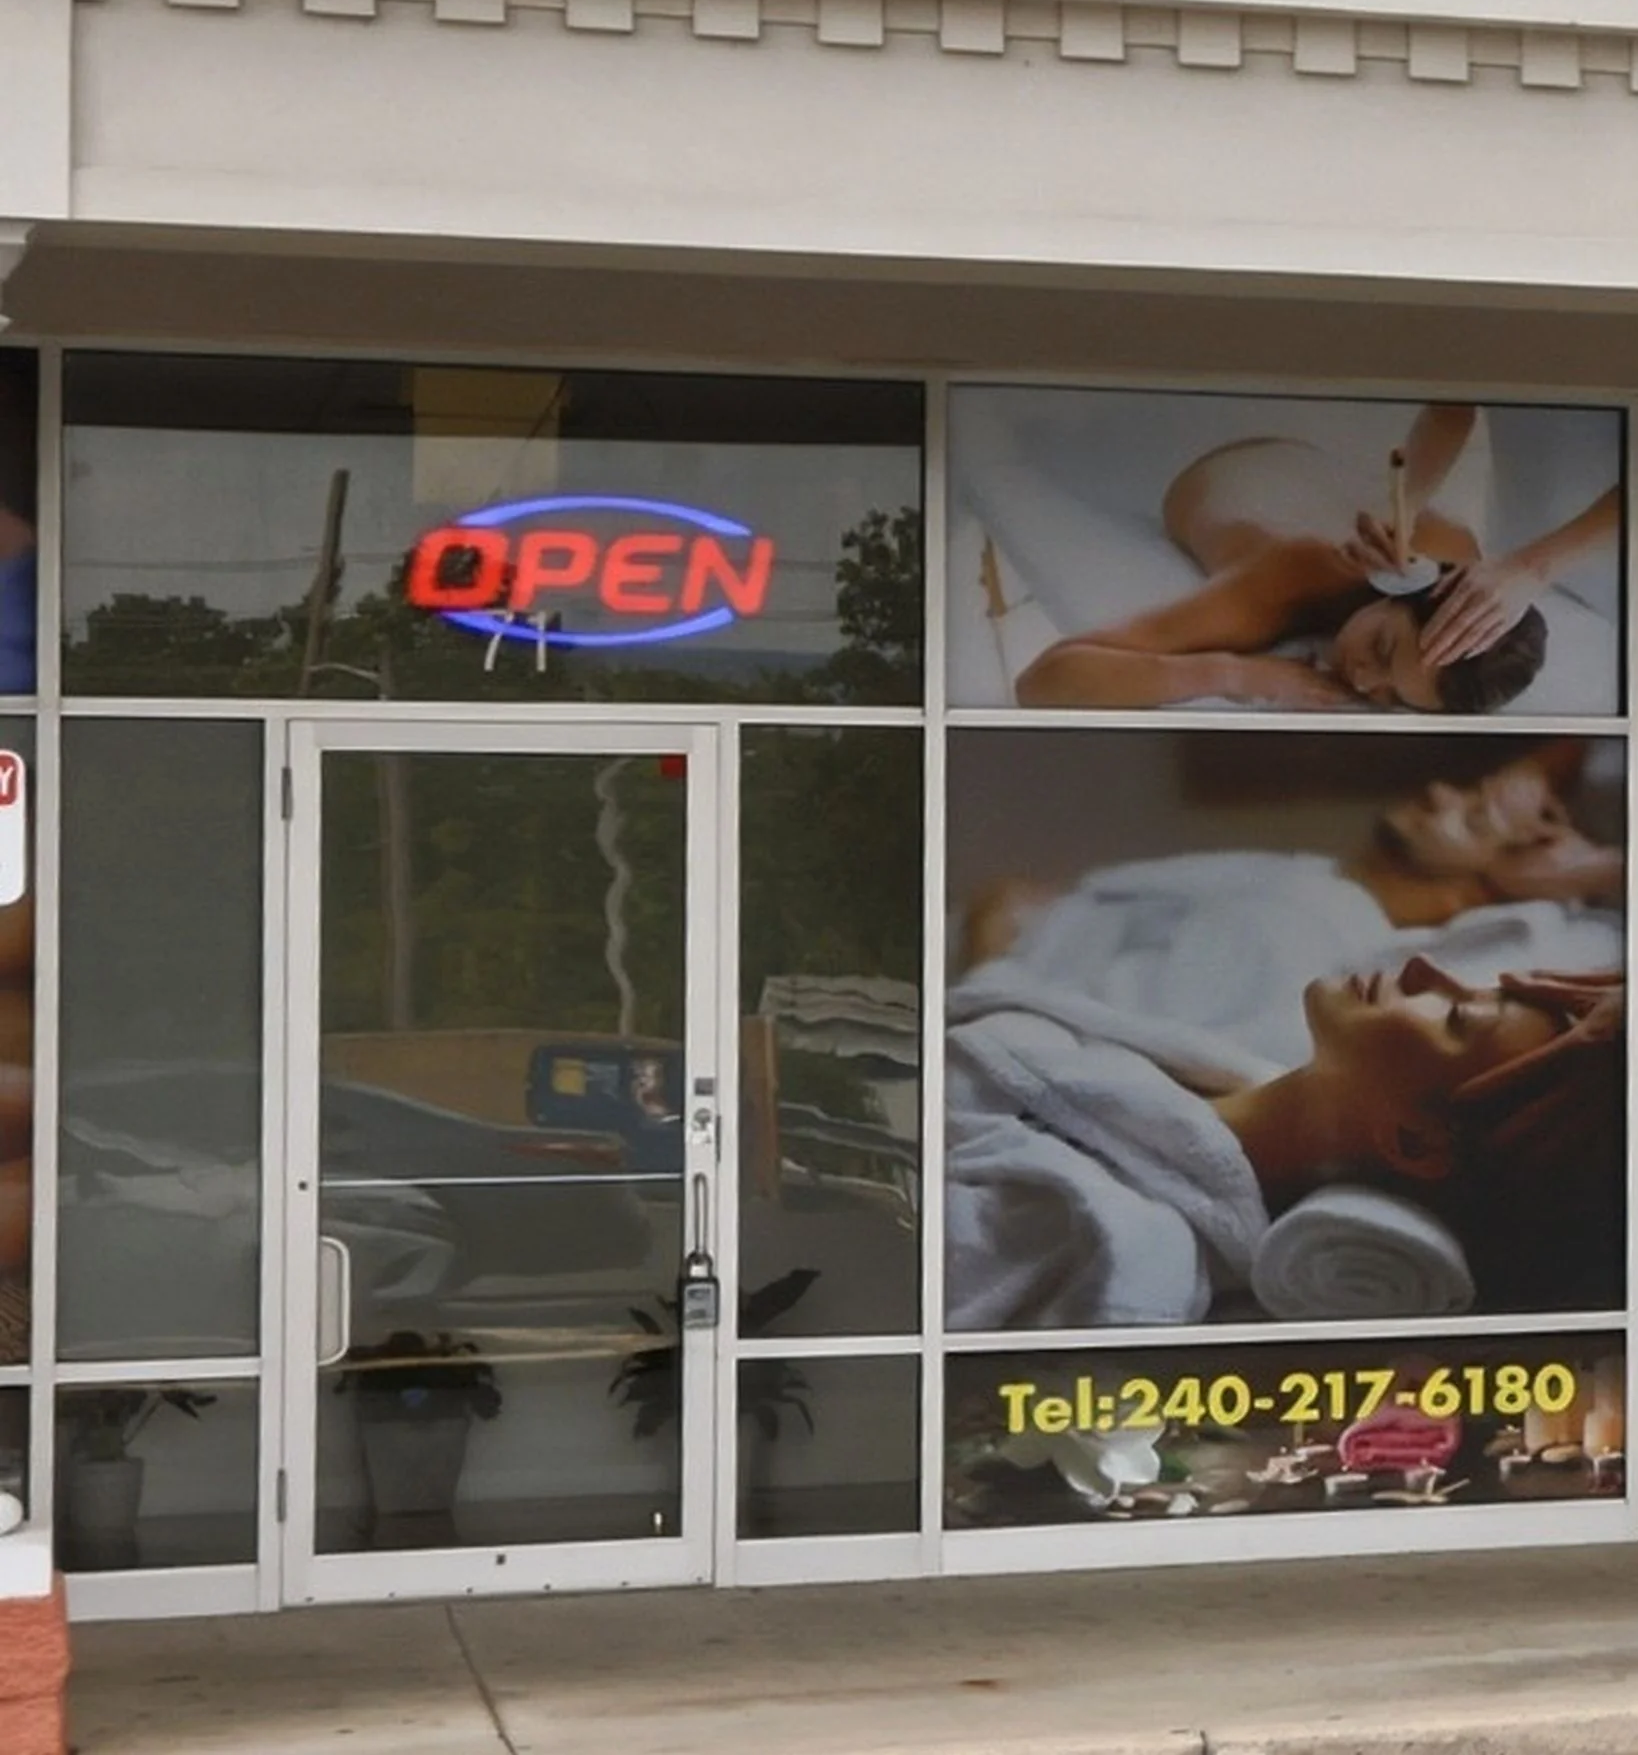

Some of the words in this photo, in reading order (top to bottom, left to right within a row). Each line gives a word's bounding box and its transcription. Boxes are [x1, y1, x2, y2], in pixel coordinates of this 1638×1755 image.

[406, 525, 775, 617] OPEN
[484, 609, 549, 673] 71
[998, 1361, 1578, 1437] Tel:240-217-6180
